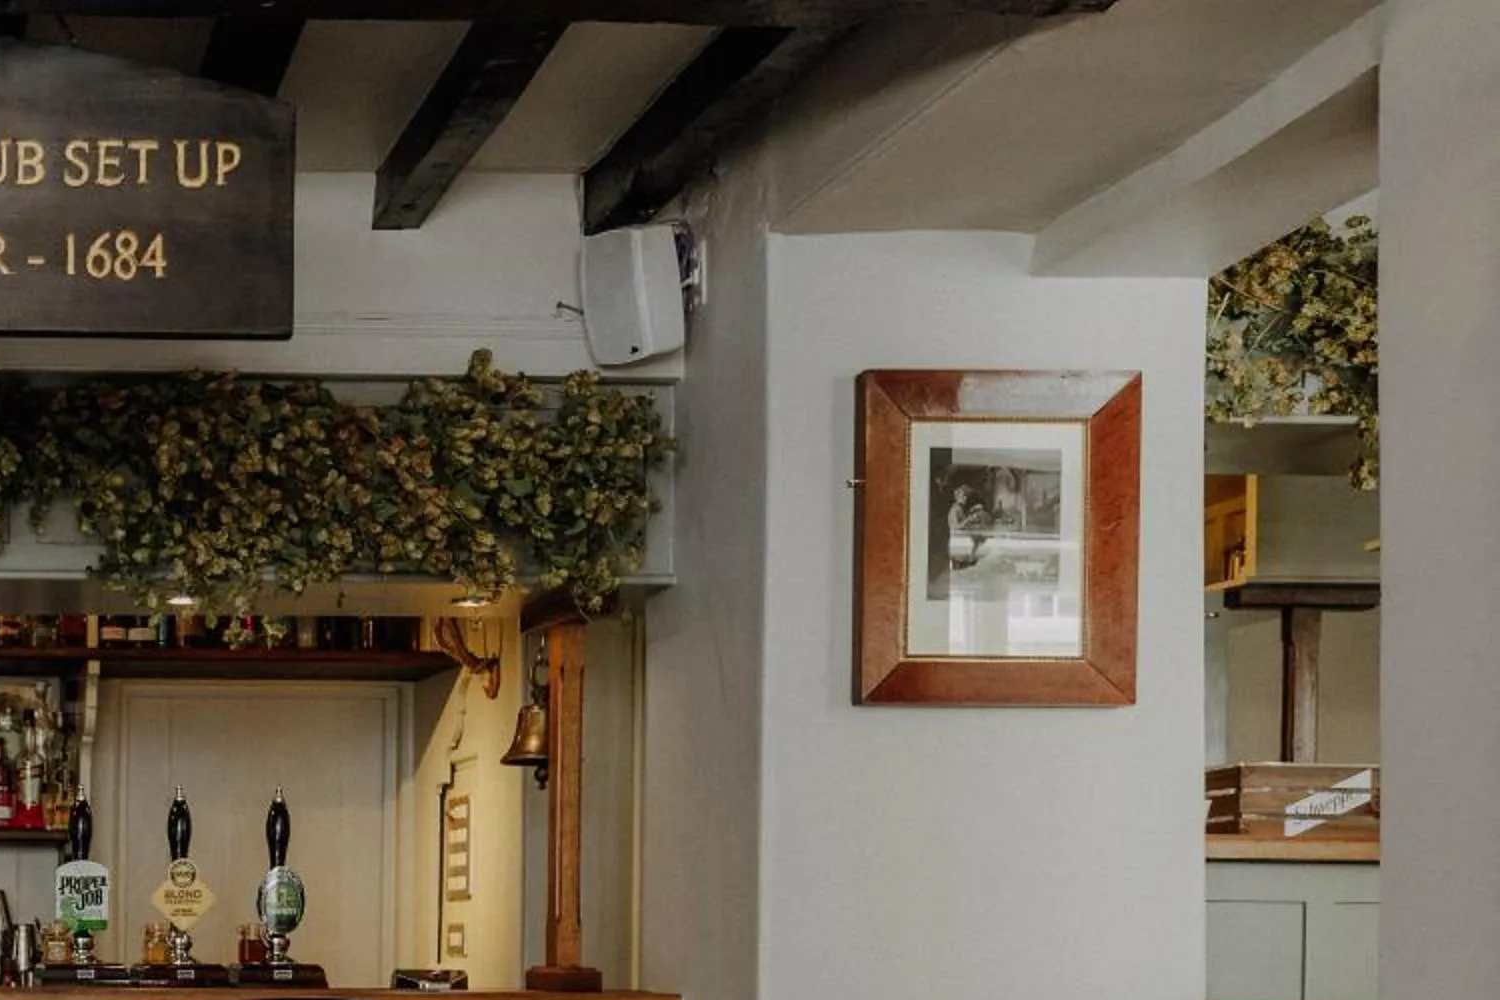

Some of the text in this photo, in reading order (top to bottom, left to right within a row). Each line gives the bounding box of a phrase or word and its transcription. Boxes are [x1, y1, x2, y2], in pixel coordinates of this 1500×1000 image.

[63, 139, 159, 187] SET
[174, 140, 241, 188] UP
[66, 230, 167, 281] 1684
[58, 875, 108, 895] PROPER
[163, 889, 203, 899] BLOND
[75, 888, 103, 911] JOB
